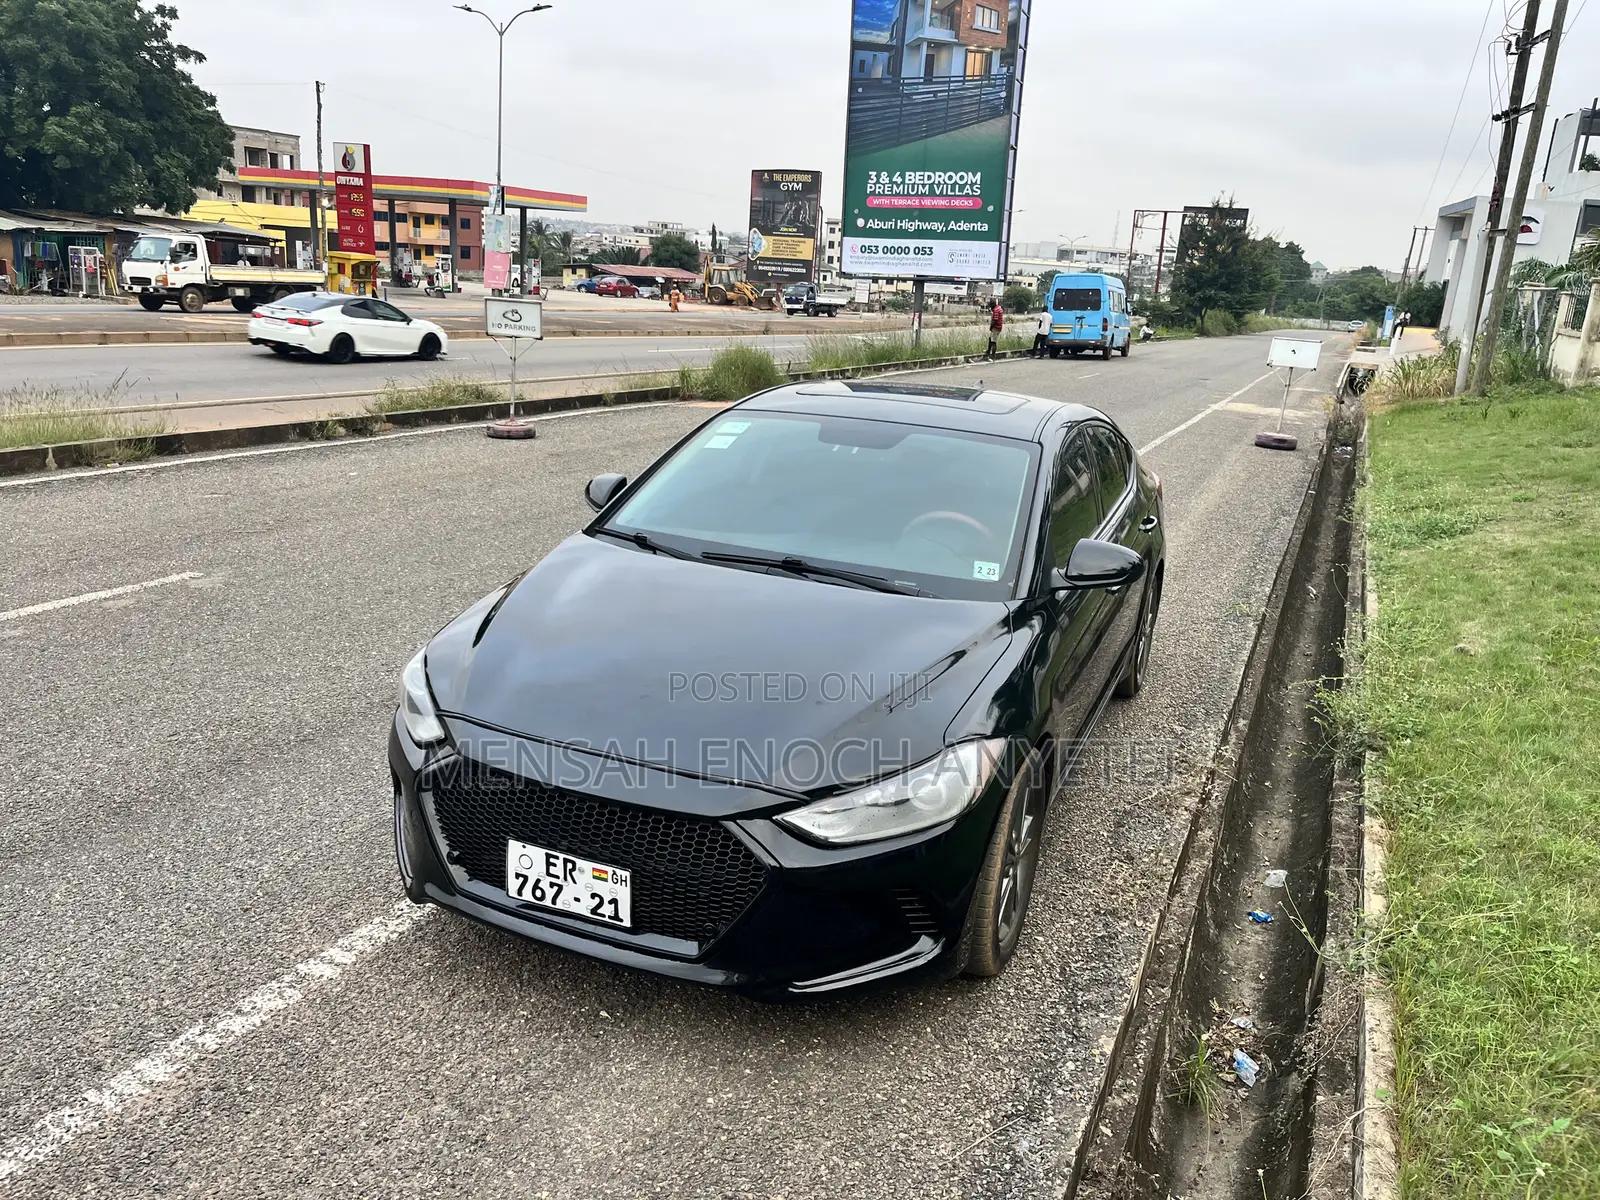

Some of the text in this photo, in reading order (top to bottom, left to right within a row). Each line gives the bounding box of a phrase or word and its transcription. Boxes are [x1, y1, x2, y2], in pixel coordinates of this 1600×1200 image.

[773, 173, 812, 183] THE EMPERORS
[868, 171, 981, 185] 3 & 4 BEDROOM
[780, 182, 802, 191] GYM
[866, 184, 981, 196] PREMIUM VILLAS
[891, 198, 920, 206] TERRACE
[921, 199, 950, 207] VIEWING
[950, 199, 974, 207] DECKS
[866, 219, 989, 233] Aburi Highway, Adenta
[860, 244, 934, 256] 053 0000 053
[504, 323, 537, 333] PARKING
[977, 566, 996, 576] 2 23
[545, 851, 628, 888] ER GH
